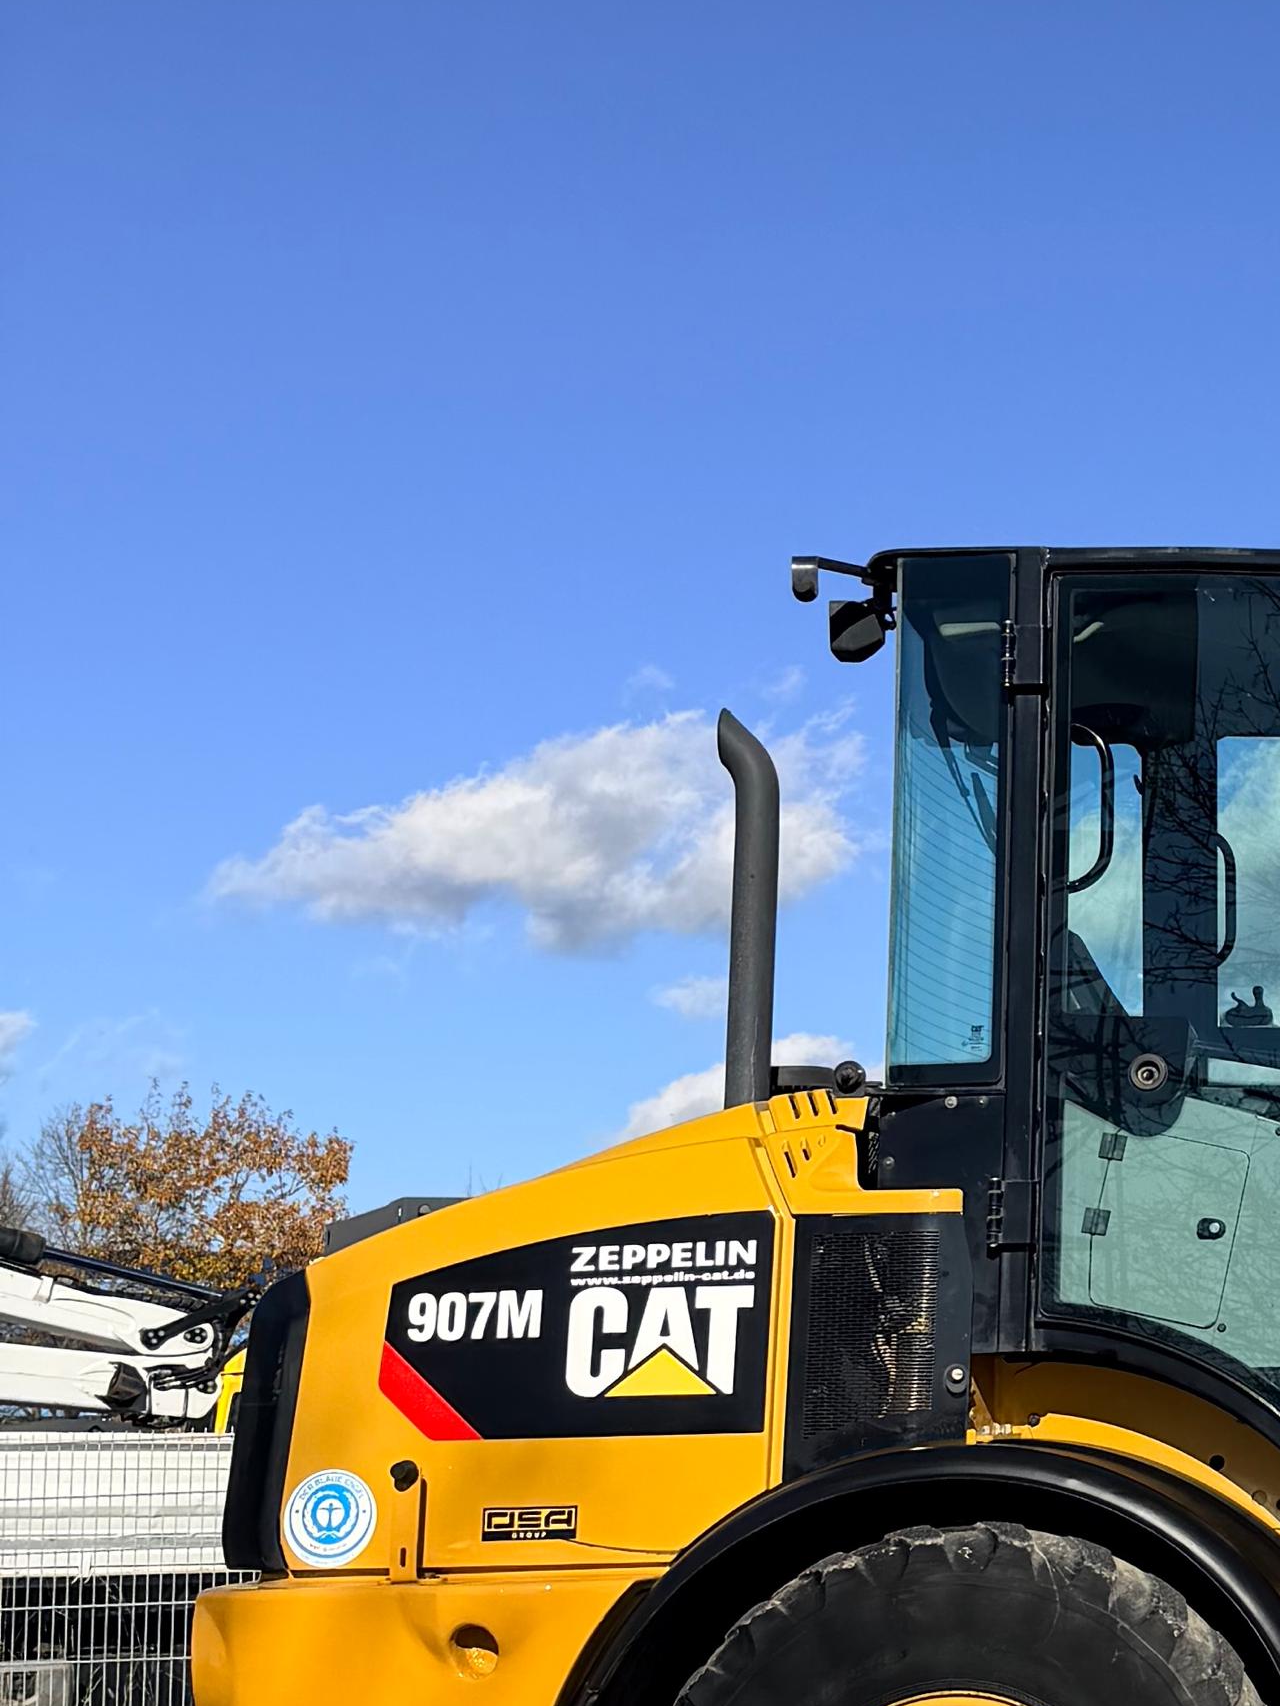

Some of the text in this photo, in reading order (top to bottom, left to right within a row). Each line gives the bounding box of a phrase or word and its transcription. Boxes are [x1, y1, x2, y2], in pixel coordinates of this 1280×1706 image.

[570, 1240, 757, 1272] ZEPPELIN
[570, 1269, 756, 1286] www.zeppelin-cat.de
[407, 1289, 543, 1342] 907M
[565, 1285, 755, 1398] CAT
